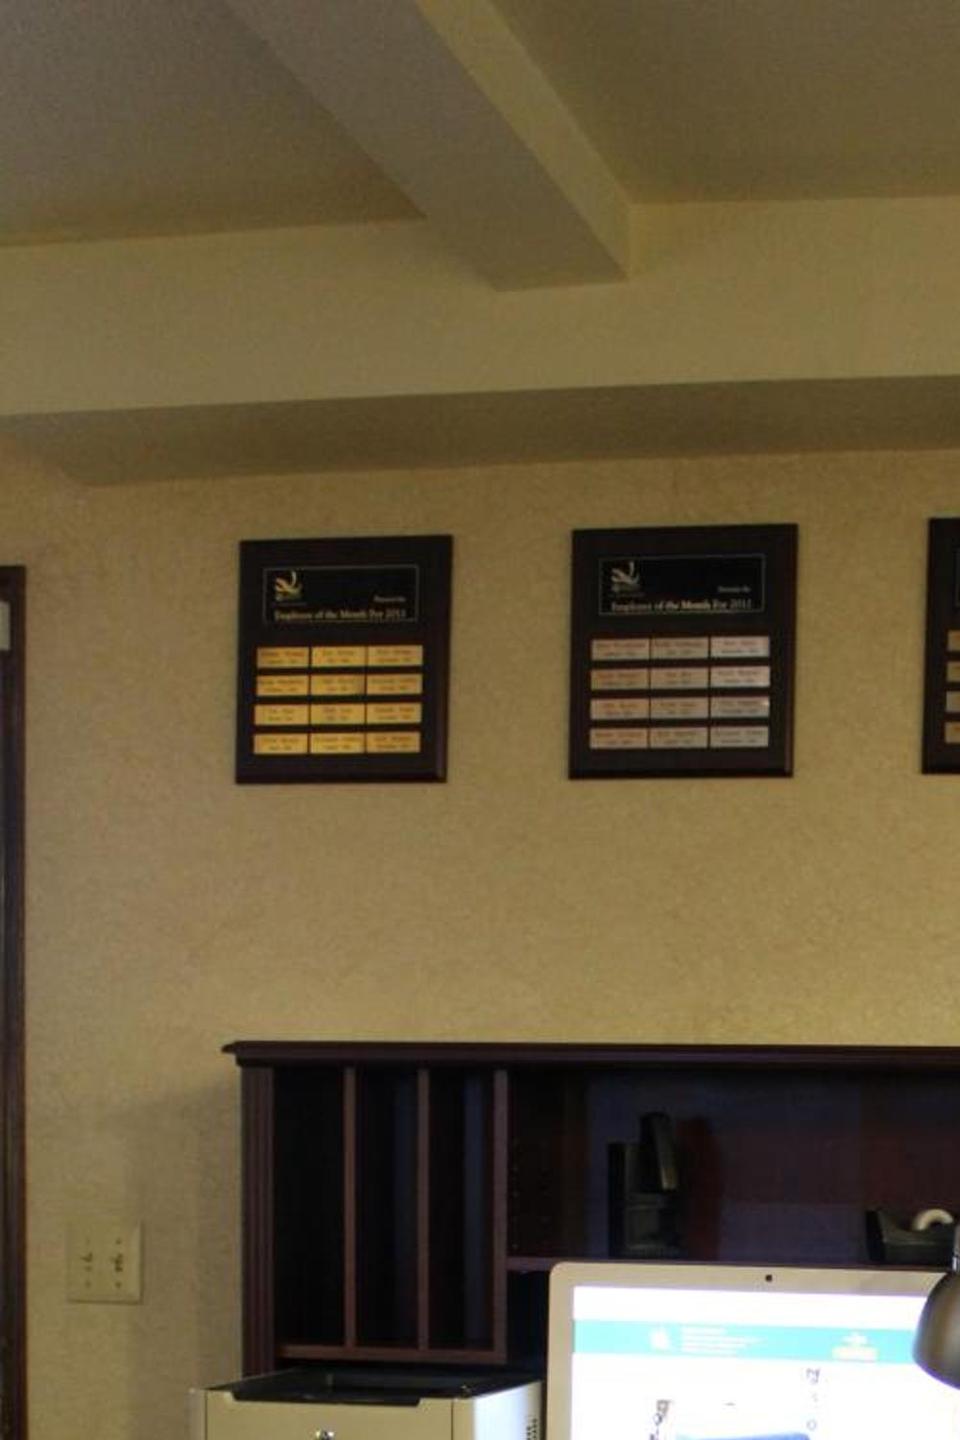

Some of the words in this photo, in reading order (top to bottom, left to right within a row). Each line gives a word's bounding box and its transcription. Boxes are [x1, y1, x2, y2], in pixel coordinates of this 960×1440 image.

[665, 600, 679, 609] the
[680, 599, 711, 609] Month
[339, 609, 367, 619] Month
